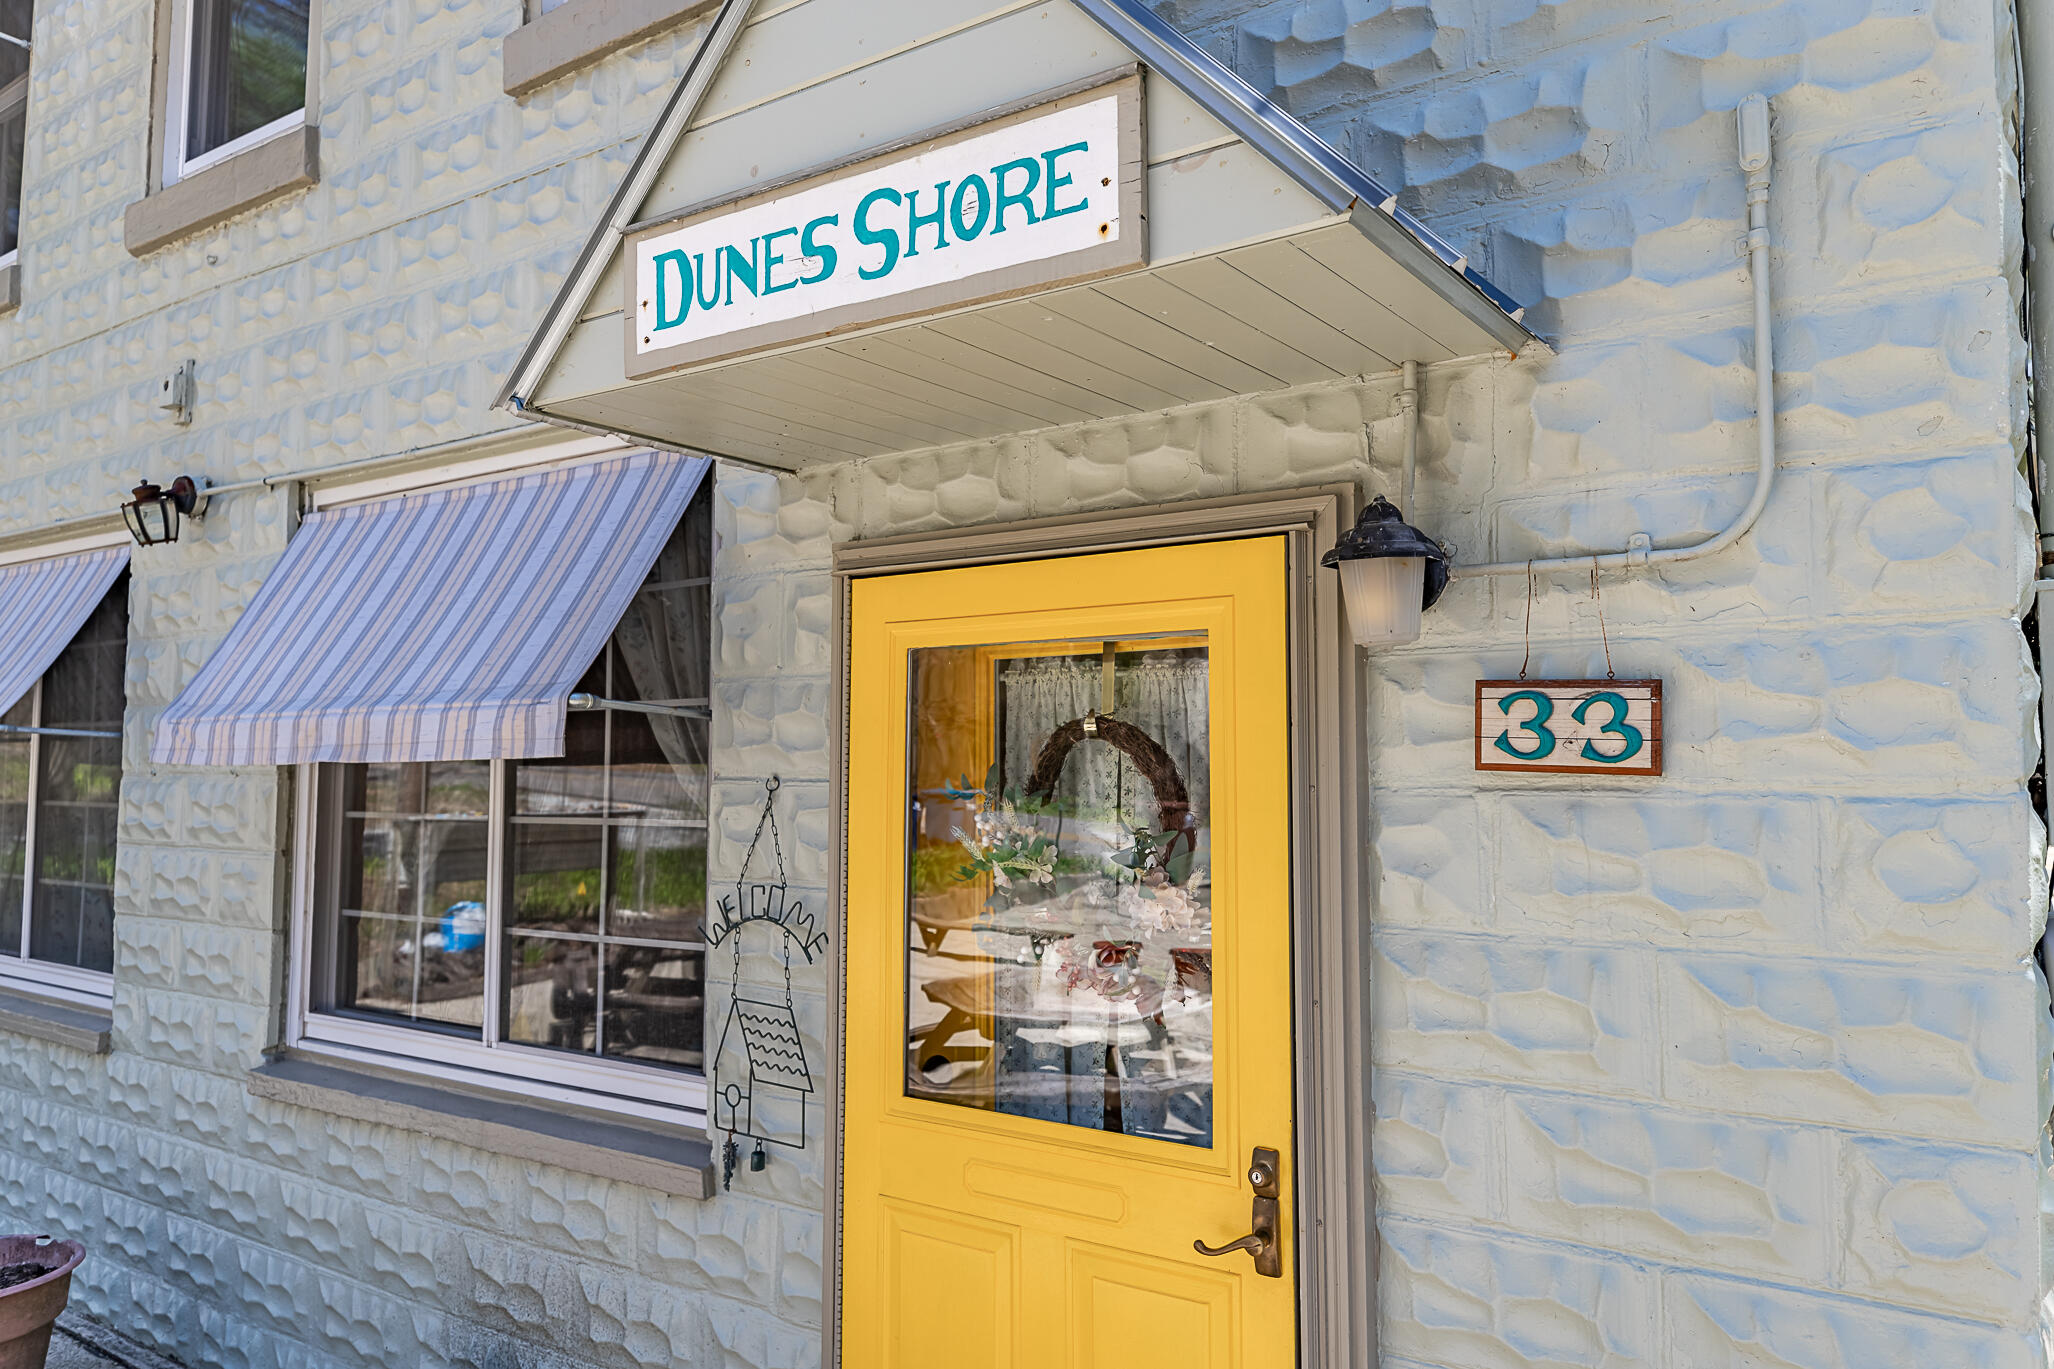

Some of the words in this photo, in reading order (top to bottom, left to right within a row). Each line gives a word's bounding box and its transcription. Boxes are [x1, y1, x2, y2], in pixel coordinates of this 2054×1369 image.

[652, 213, 839, 332] DUNES
[853, 141, 1089, 281] SHORE
[1493, 690, 1643, 764] 33
[698, 885, 830, 965] WELCOME
